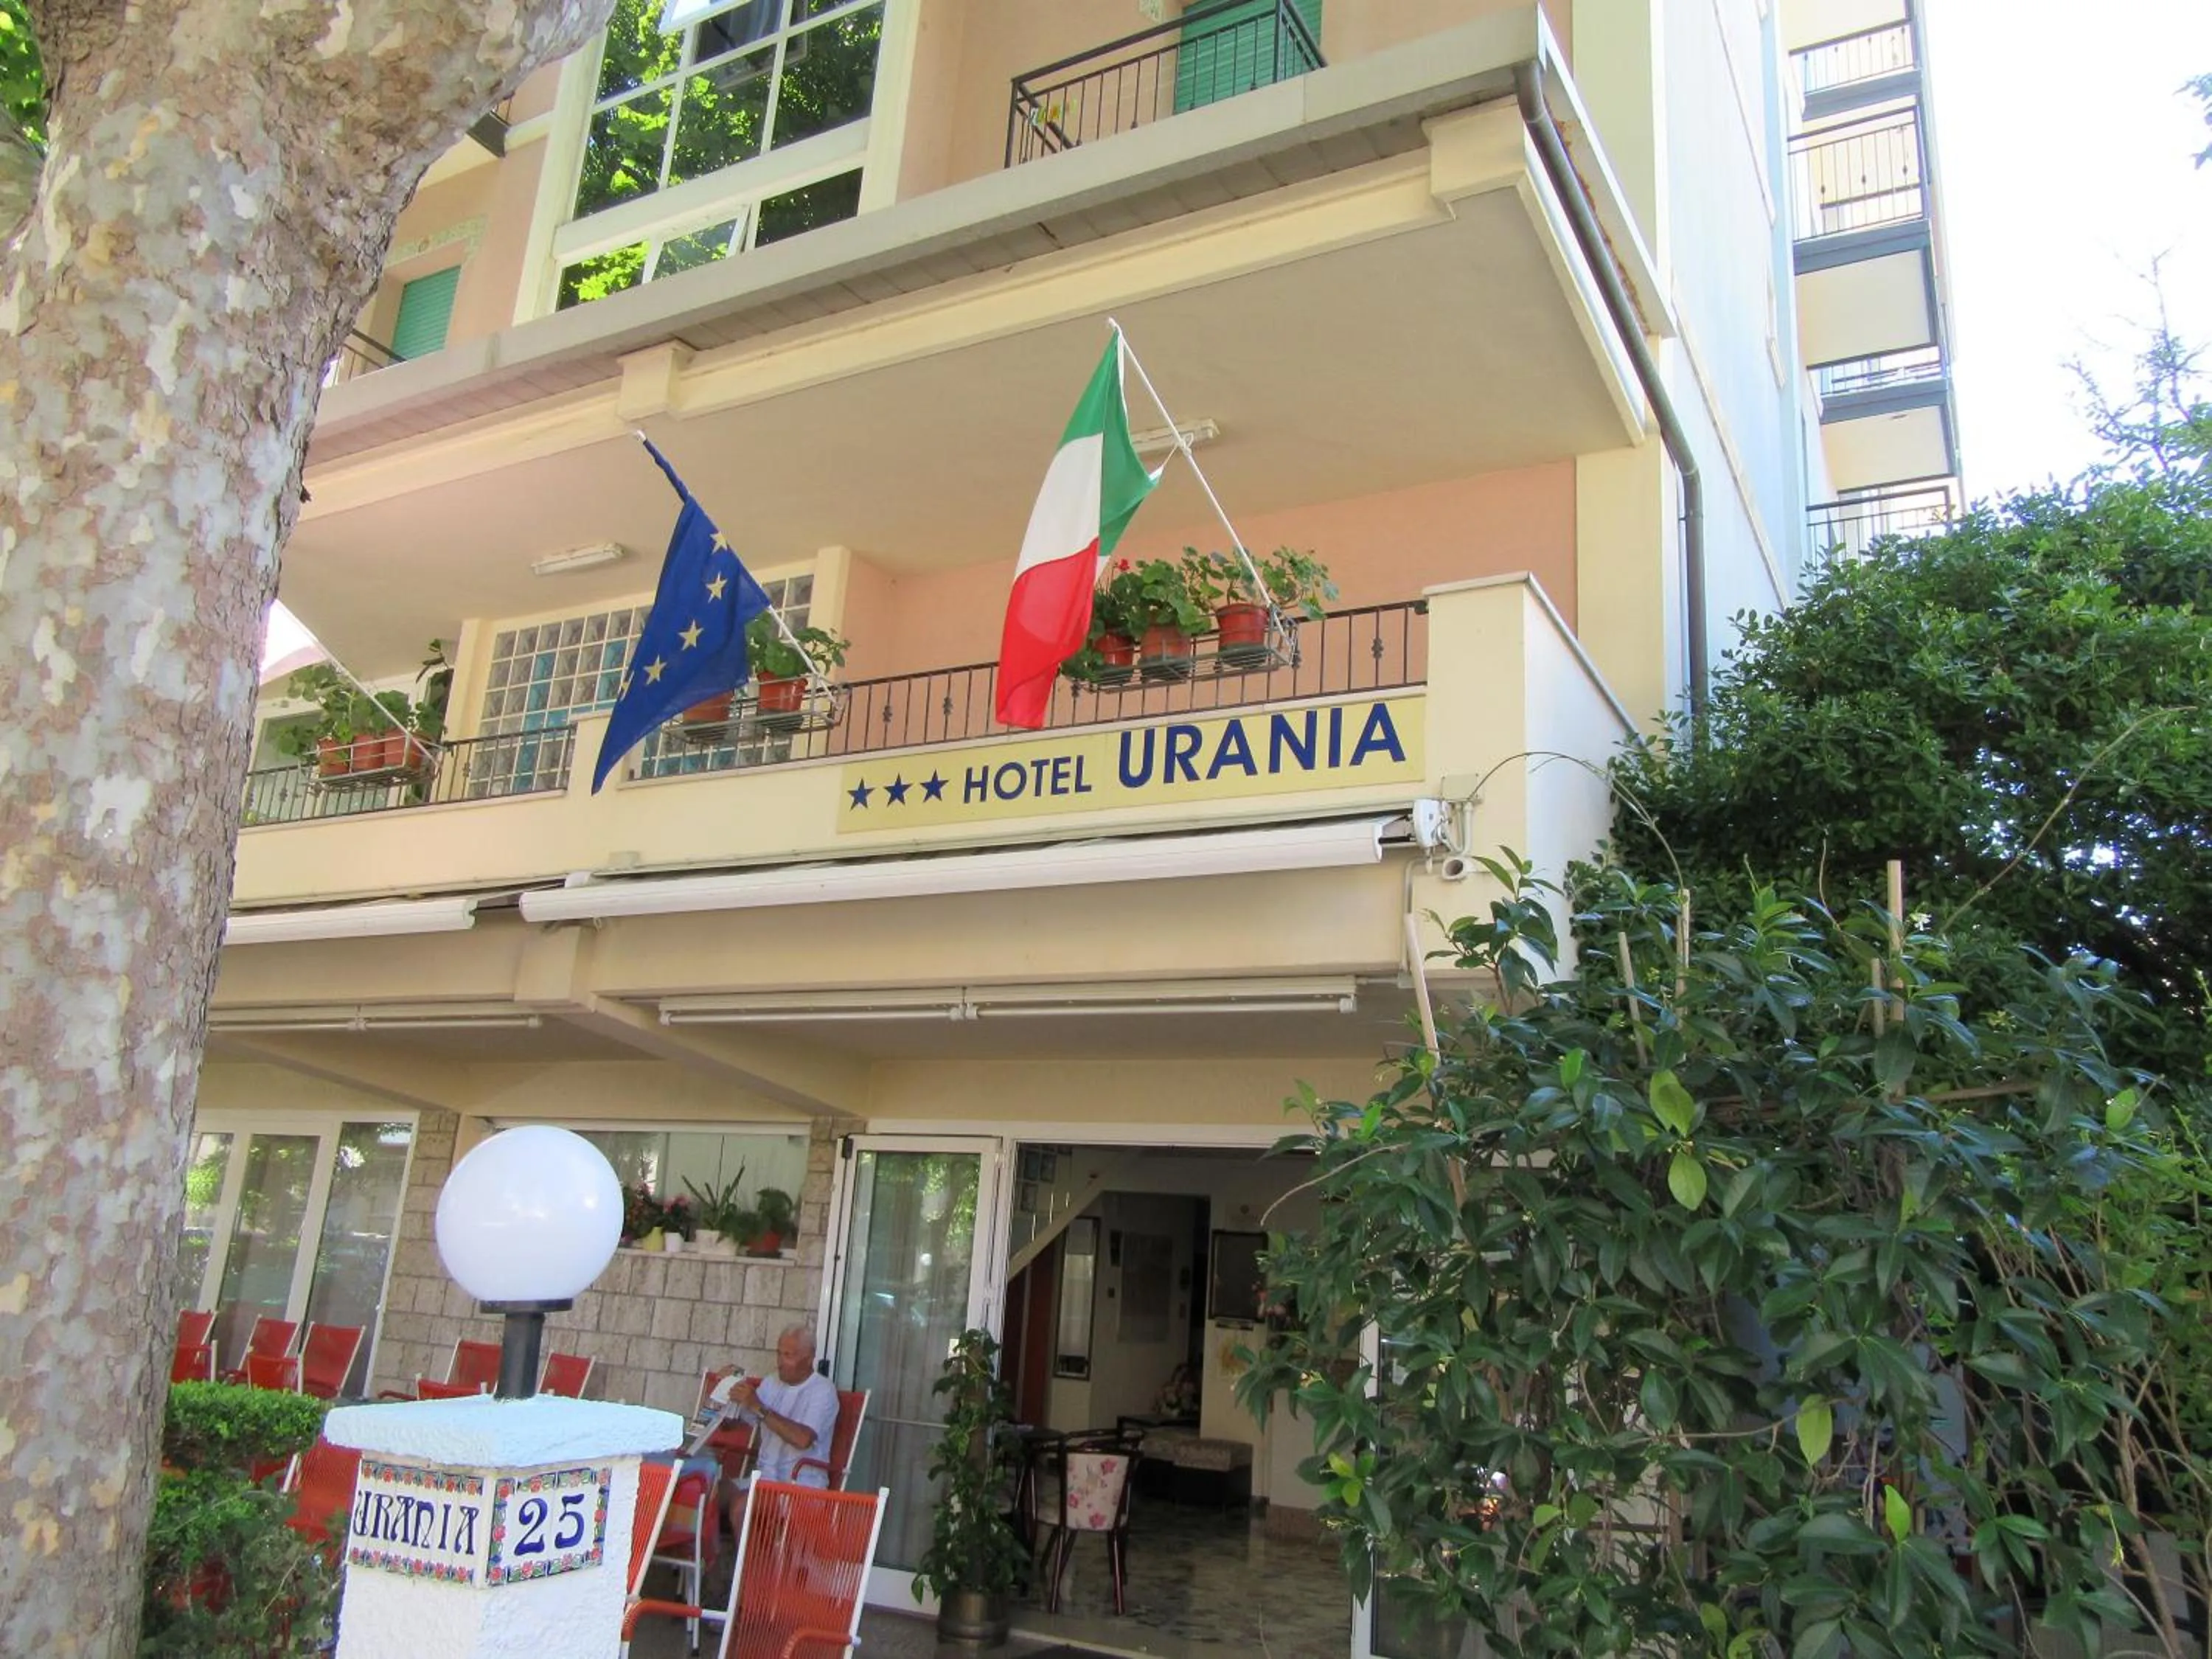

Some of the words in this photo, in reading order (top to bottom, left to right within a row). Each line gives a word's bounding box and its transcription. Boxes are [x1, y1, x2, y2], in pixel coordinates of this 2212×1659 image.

[963, 754, 1093, 804] HOTEL
[1118, 702, 1406, 789] URANIA
[352, 1489, 479, 1556] URANIA
[513, 1492, 585, 1557] 25
